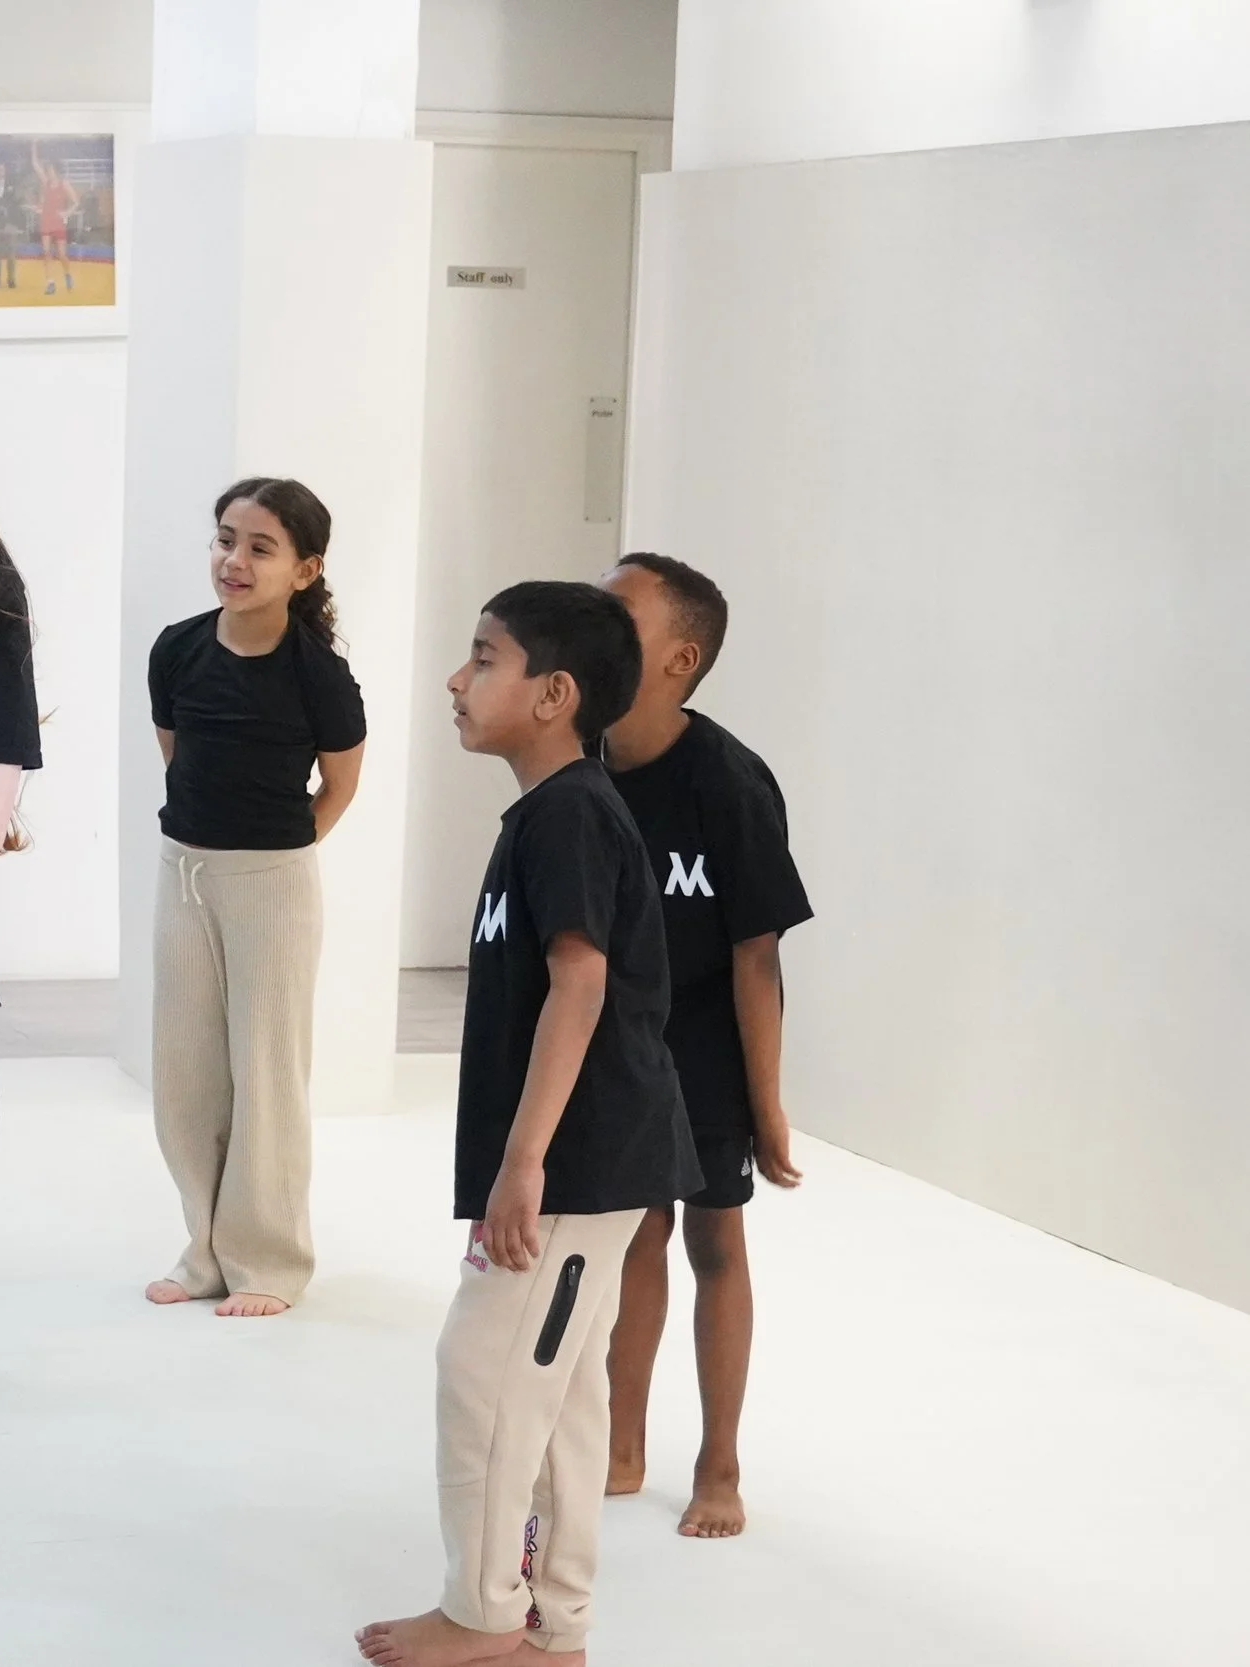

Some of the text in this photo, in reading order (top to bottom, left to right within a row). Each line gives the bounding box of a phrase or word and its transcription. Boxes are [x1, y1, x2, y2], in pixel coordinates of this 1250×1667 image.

[457, 271, 514, 288] Staff only
[664, 852, 715, 897] M
[475, 890, 507, 943] M
